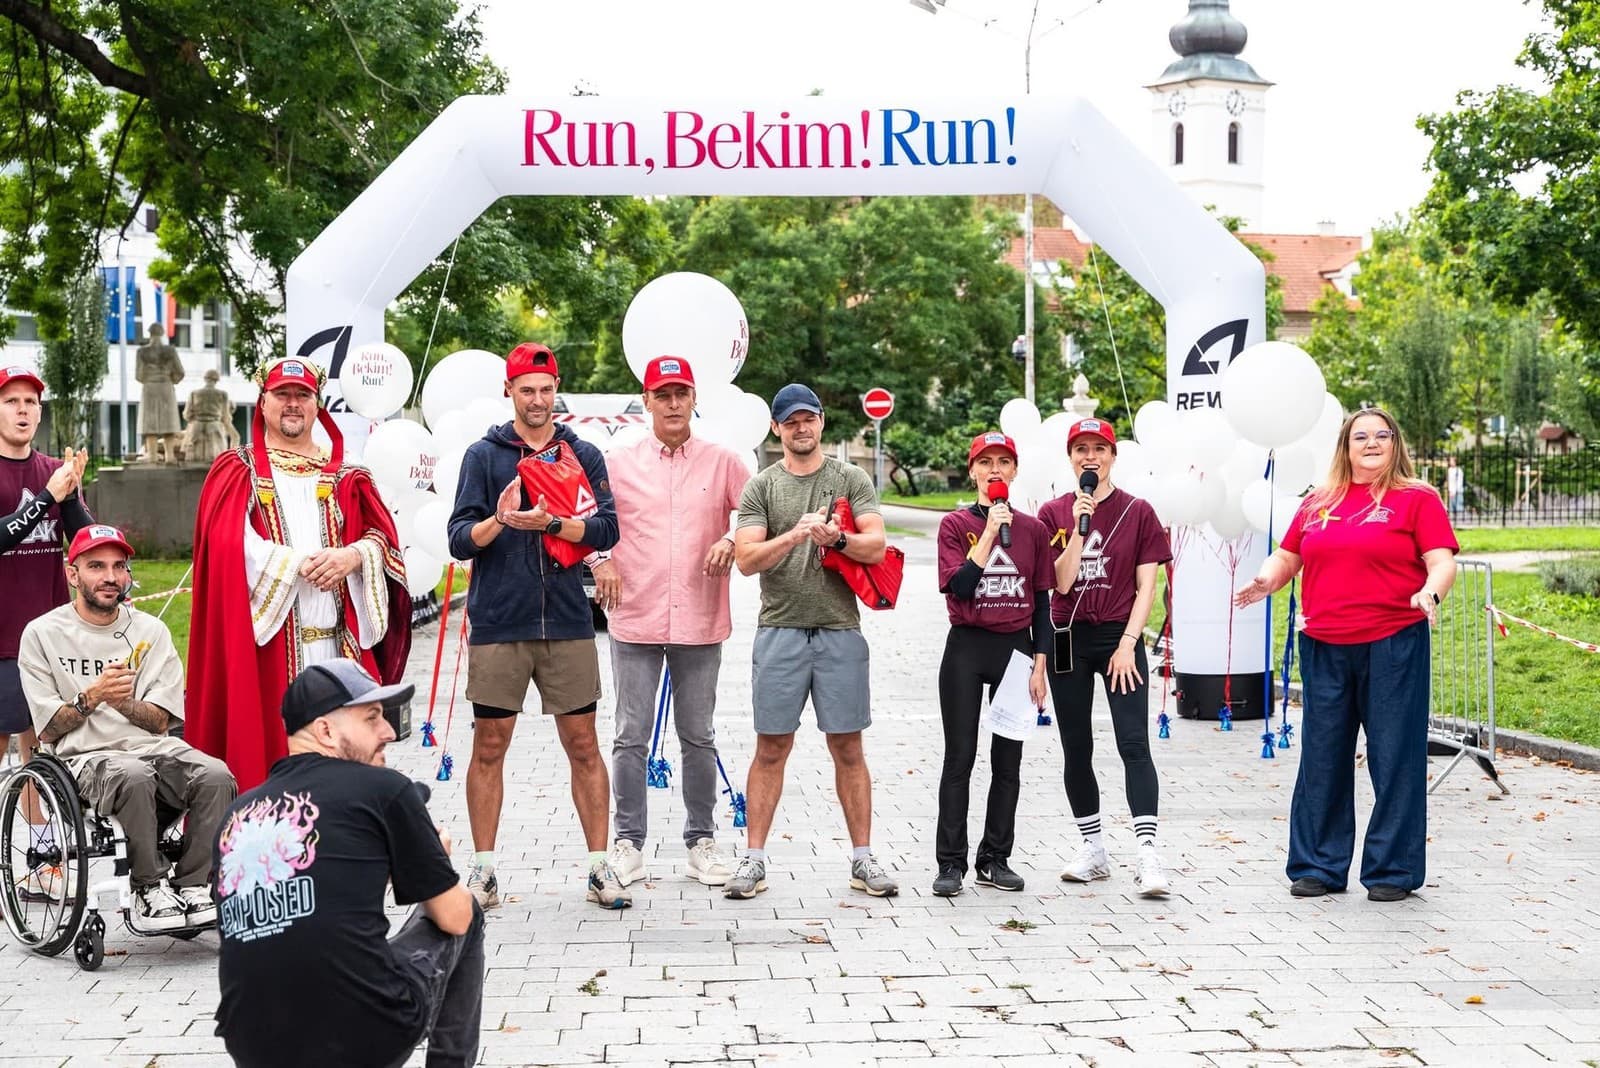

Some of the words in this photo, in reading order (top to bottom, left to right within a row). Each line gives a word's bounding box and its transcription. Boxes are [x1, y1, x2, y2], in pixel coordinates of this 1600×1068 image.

[521, 109, 655, 175] Run,
[662, 109, 872, 169] Bekim!
[879, 107, 1017, 167] Run!
[352, 363, 393, 376] Bekim!
[362, 376, 384, 387] Run!
[975, 576, 1027, 599] PEAK
[220, 875, 316, 939] EXPOSED
